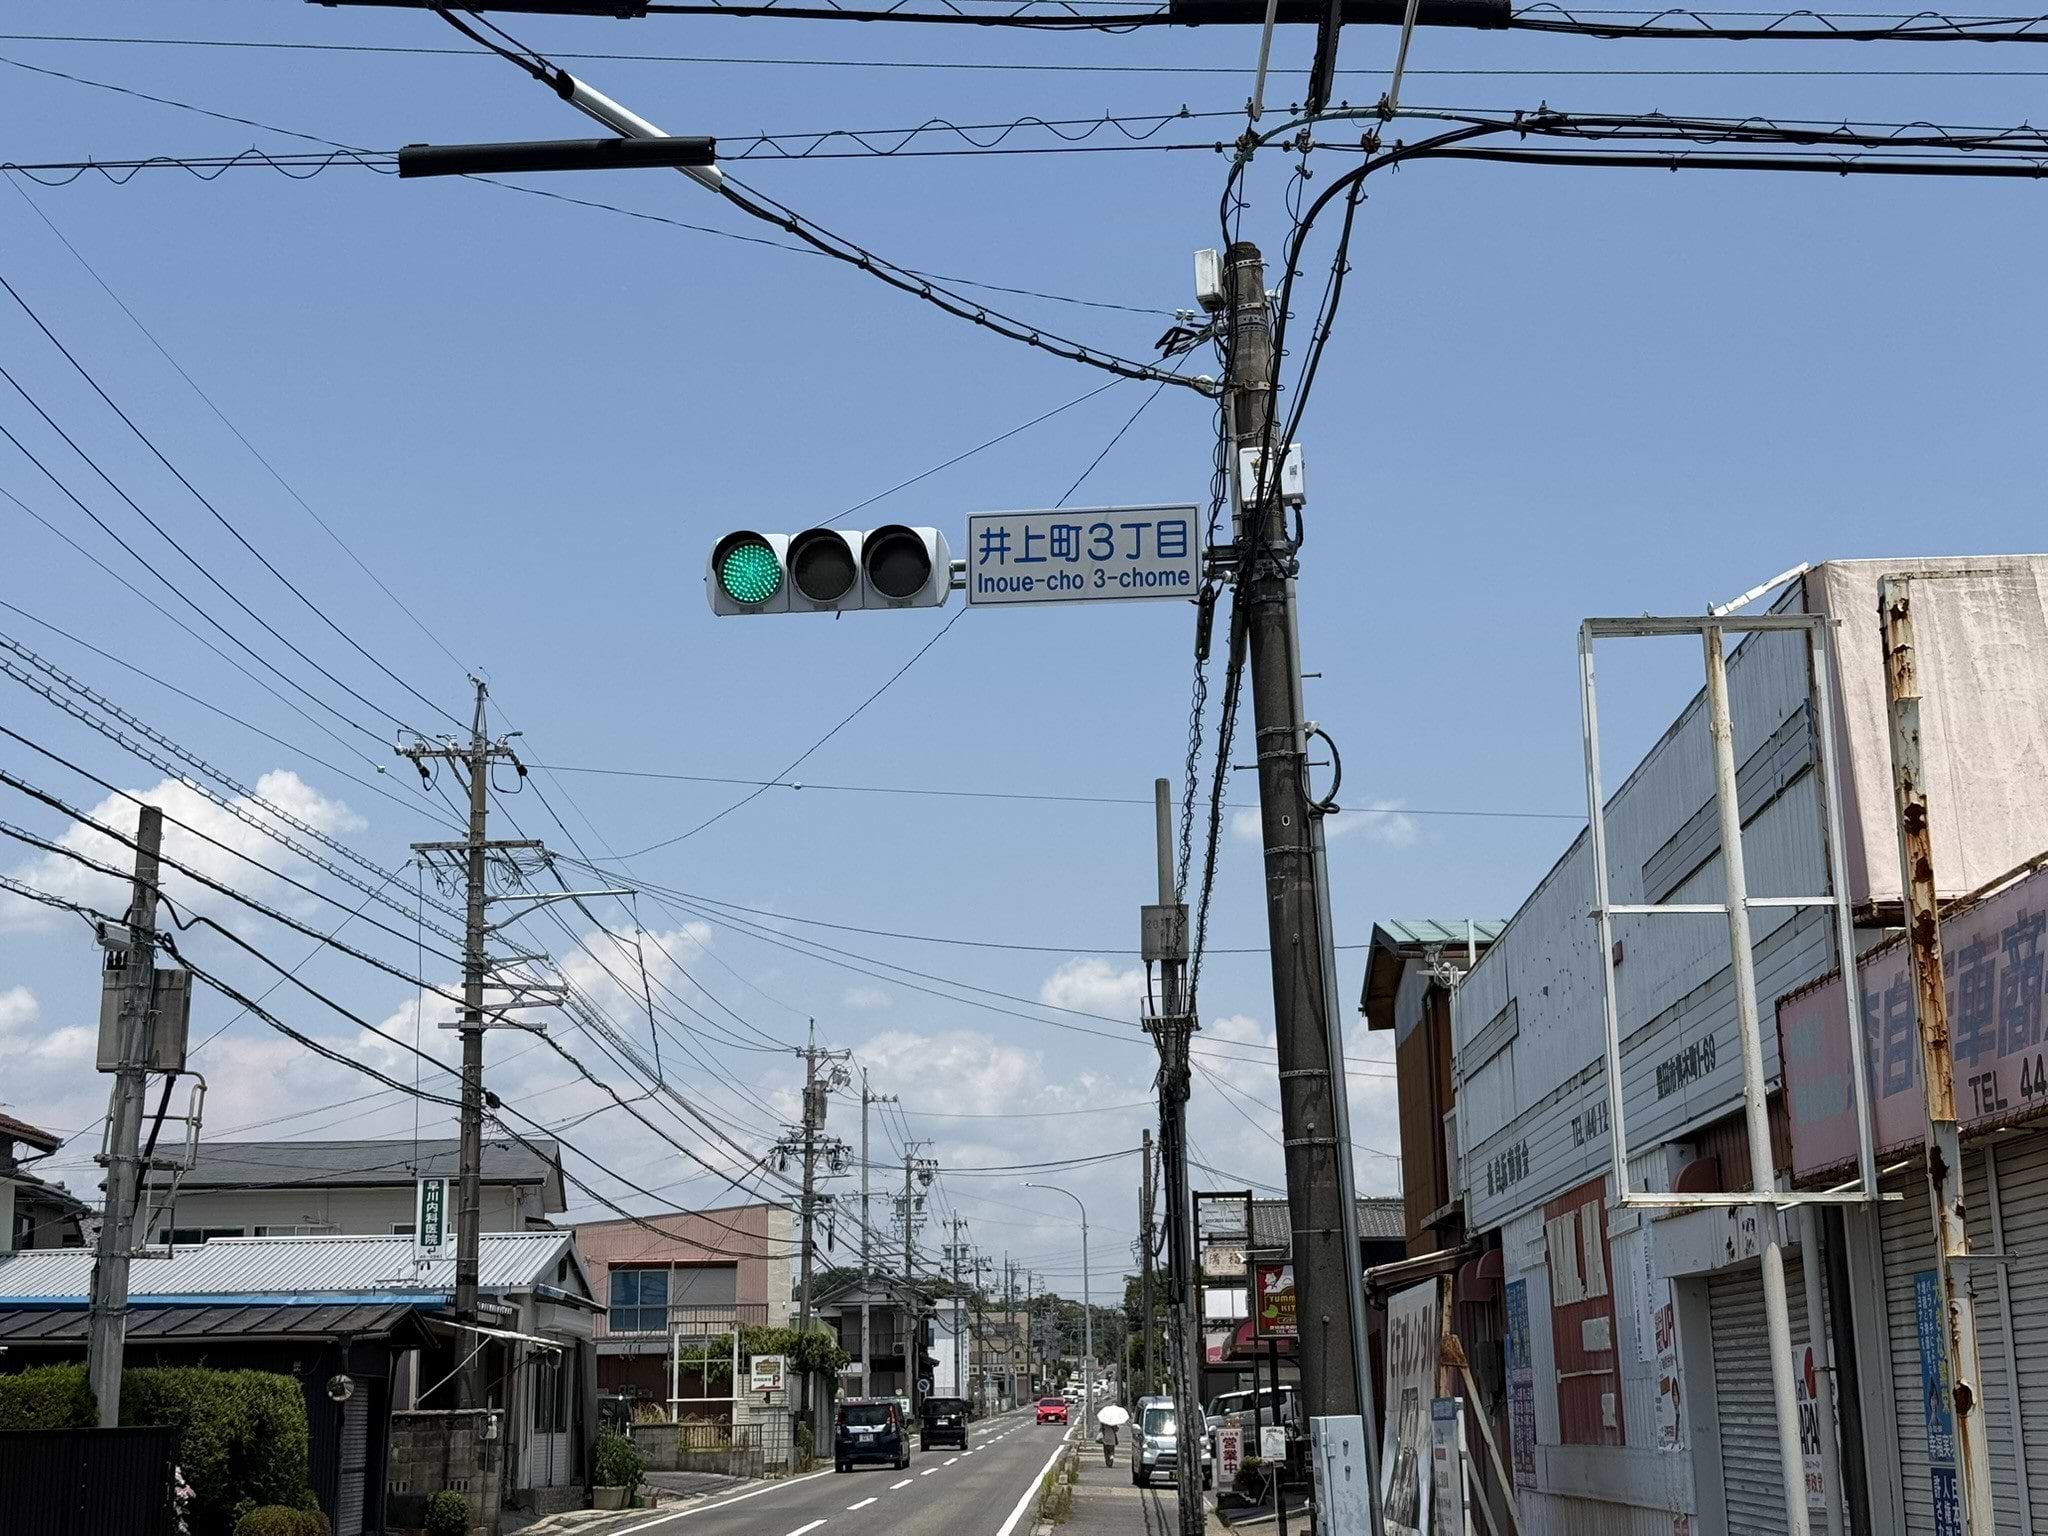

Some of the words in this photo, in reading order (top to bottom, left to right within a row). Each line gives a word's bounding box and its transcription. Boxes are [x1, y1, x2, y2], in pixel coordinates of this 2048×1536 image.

[979, 520, 1187, 565] 井上町3丁目
[978, 570, 1084, 593] Inoue-cho
[1094, 568, 1190, 588] 3-chome
[1968, 1070, 2007, 1116] TEL
[425, 1181, 440, 1245] 早川内科医院
[772, 1375, 781, 1386] P
[1223, 1437, 1237, 1474] 営業中
